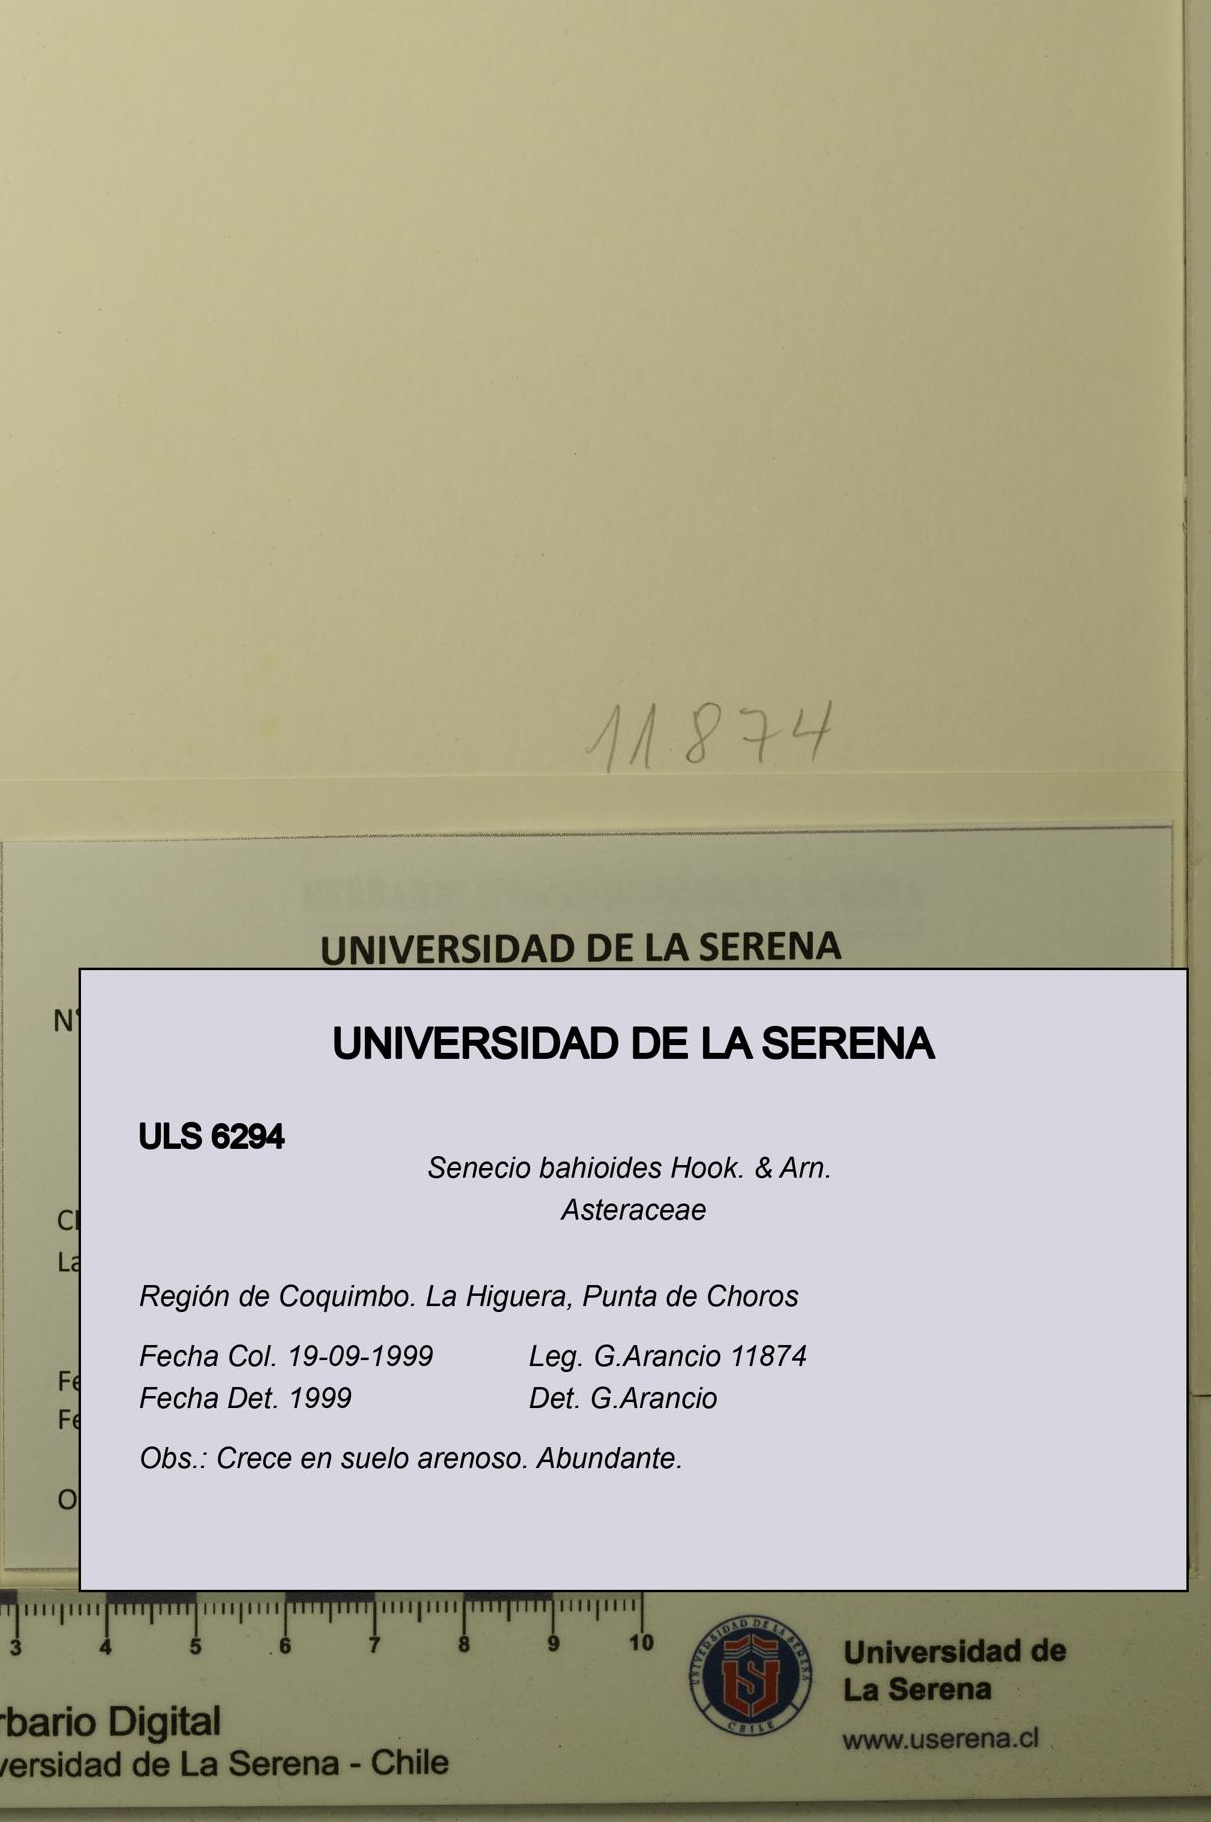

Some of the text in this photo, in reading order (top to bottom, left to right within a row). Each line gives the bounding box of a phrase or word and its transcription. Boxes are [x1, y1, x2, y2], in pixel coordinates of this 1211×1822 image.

[585, 699, 833, 773] 11874
[321, 930, 843, 966] UNIVERSIDAD DE LA SERENA
[9, 1638, 22, 1657] 3
[98, 1637, 113, 1656] 4
[189, 1637, 202, 1656] 5
[279, 1636, 292, 1655] 6
[368, 1635, 381, 1654] 7
[458, 1634, 471, 1653] 8
[547, 1634, 561, 1653] 9
[629, 1633, 655, 1652] 10
[692, 1618, 810, 1685] UNIVERSIDAD DE LA SERENA
[844, 1637, 1067, 1665] Universidad de
[844, 1676, 992, 1702] La Serena
[109, 1704, 221, 1745] Digital
[842, 1725, 1039, 1751] www.userena.cl
[132, 1750, 171, 1778] de
[181, 1750, 218, 1778] La
[228, 1749, 340, 1777] Serena
[371, 1748, 450, 1776] Chile
